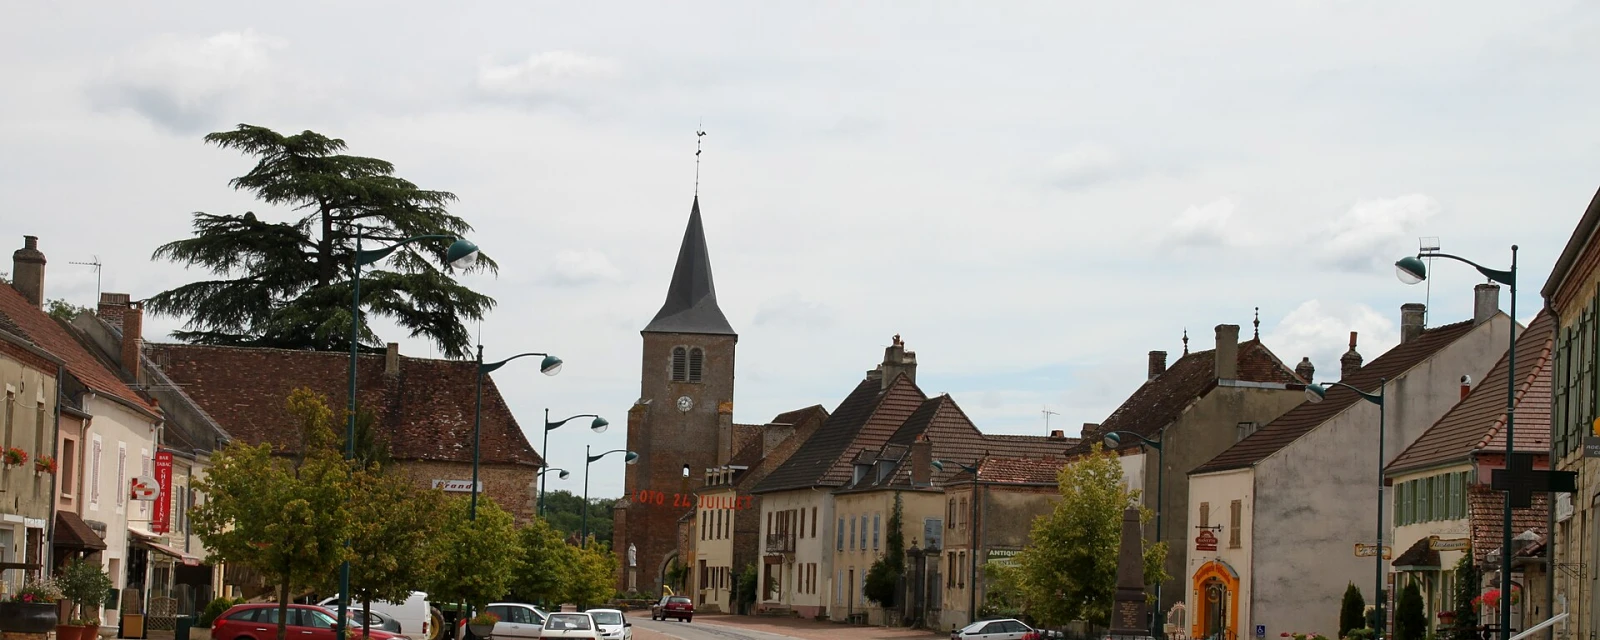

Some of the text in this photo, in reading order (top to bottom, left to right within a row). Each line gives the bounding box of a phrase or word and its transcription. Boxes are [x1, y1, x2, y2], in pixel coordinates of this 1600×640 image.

[631, 487, 754, 510] LOTO 24 JUILLET
